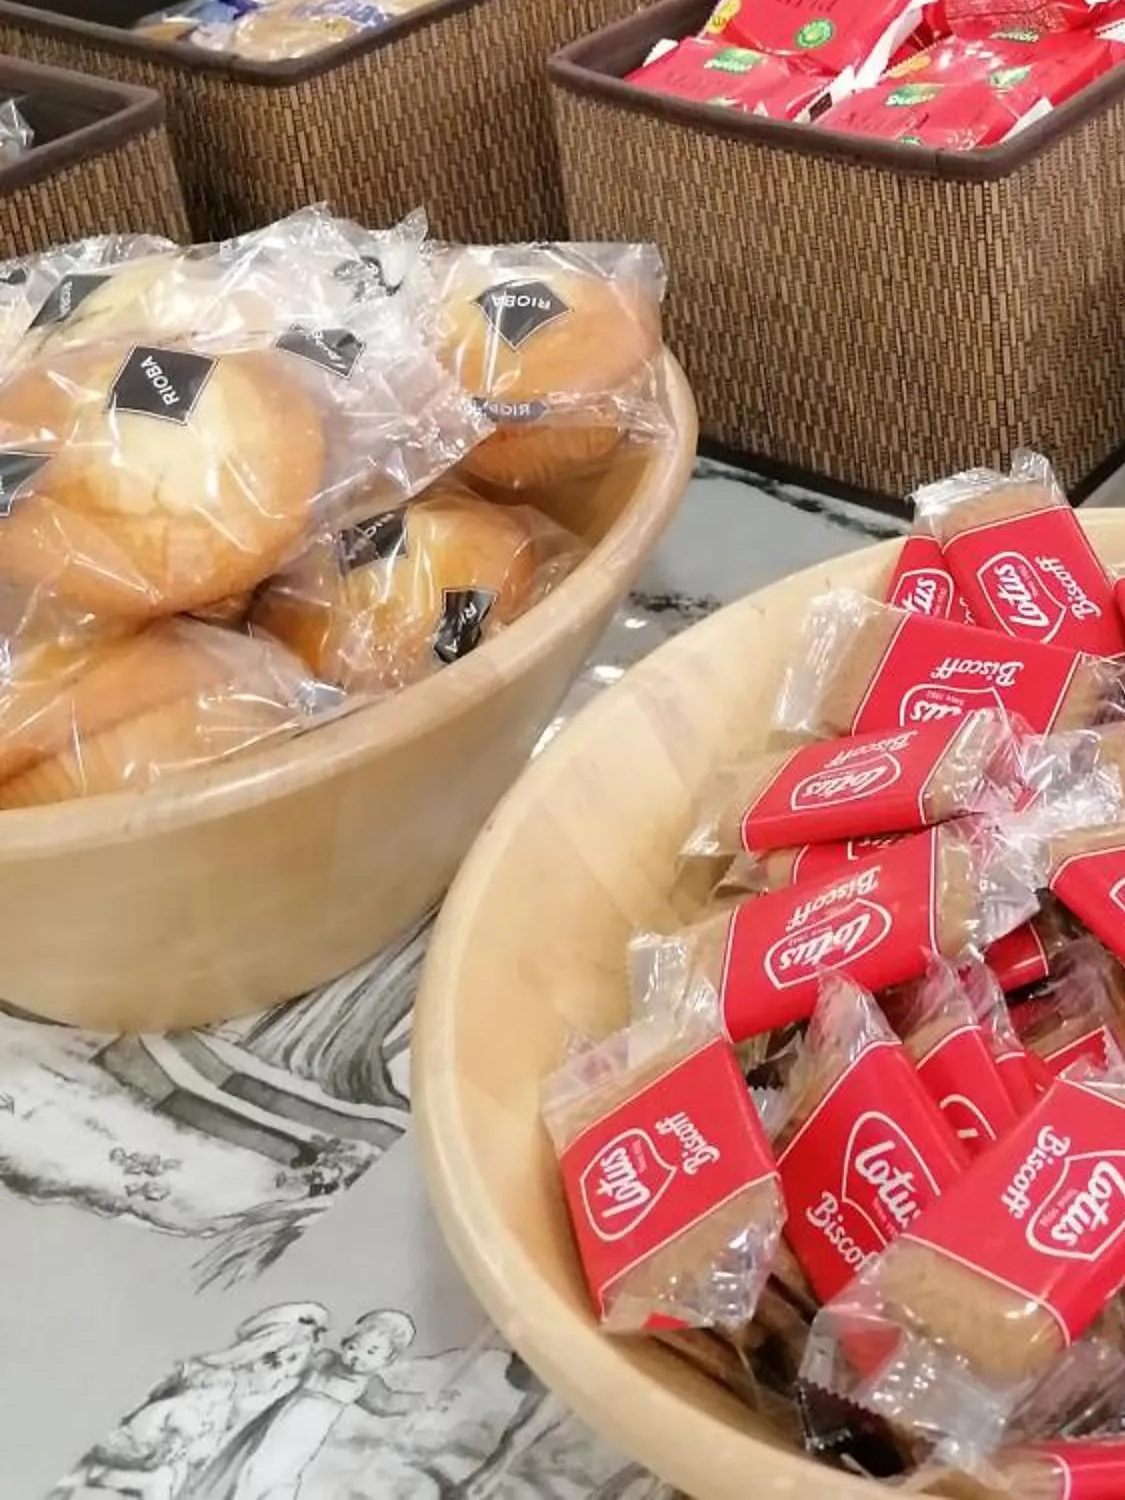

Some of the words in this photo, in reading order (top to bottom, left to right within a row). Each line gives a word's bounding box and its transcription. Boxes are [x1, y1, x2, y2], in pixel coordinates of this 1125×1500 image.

[490, 293, 552, 310] RIOBA
[139, 355, 181, 405] RIOBA
[994, 563, 1050, 627] Lotus
[1035, 555, 1102, 620] Biscoff
[931, 657, 1025, 687] Biscoff
[824, 730, 918, 769] Biscoff
[802, 764, 888, 798] Lotus
[785, 865, 881, 931] Biscoff
[778, 912, 871, 970] Lotus
[656, 1111, 720, 1176] Biscoff
[1002, 1124, 1071, 1219] Biscoff
[596, 1147, 651, 1219] Lotus
